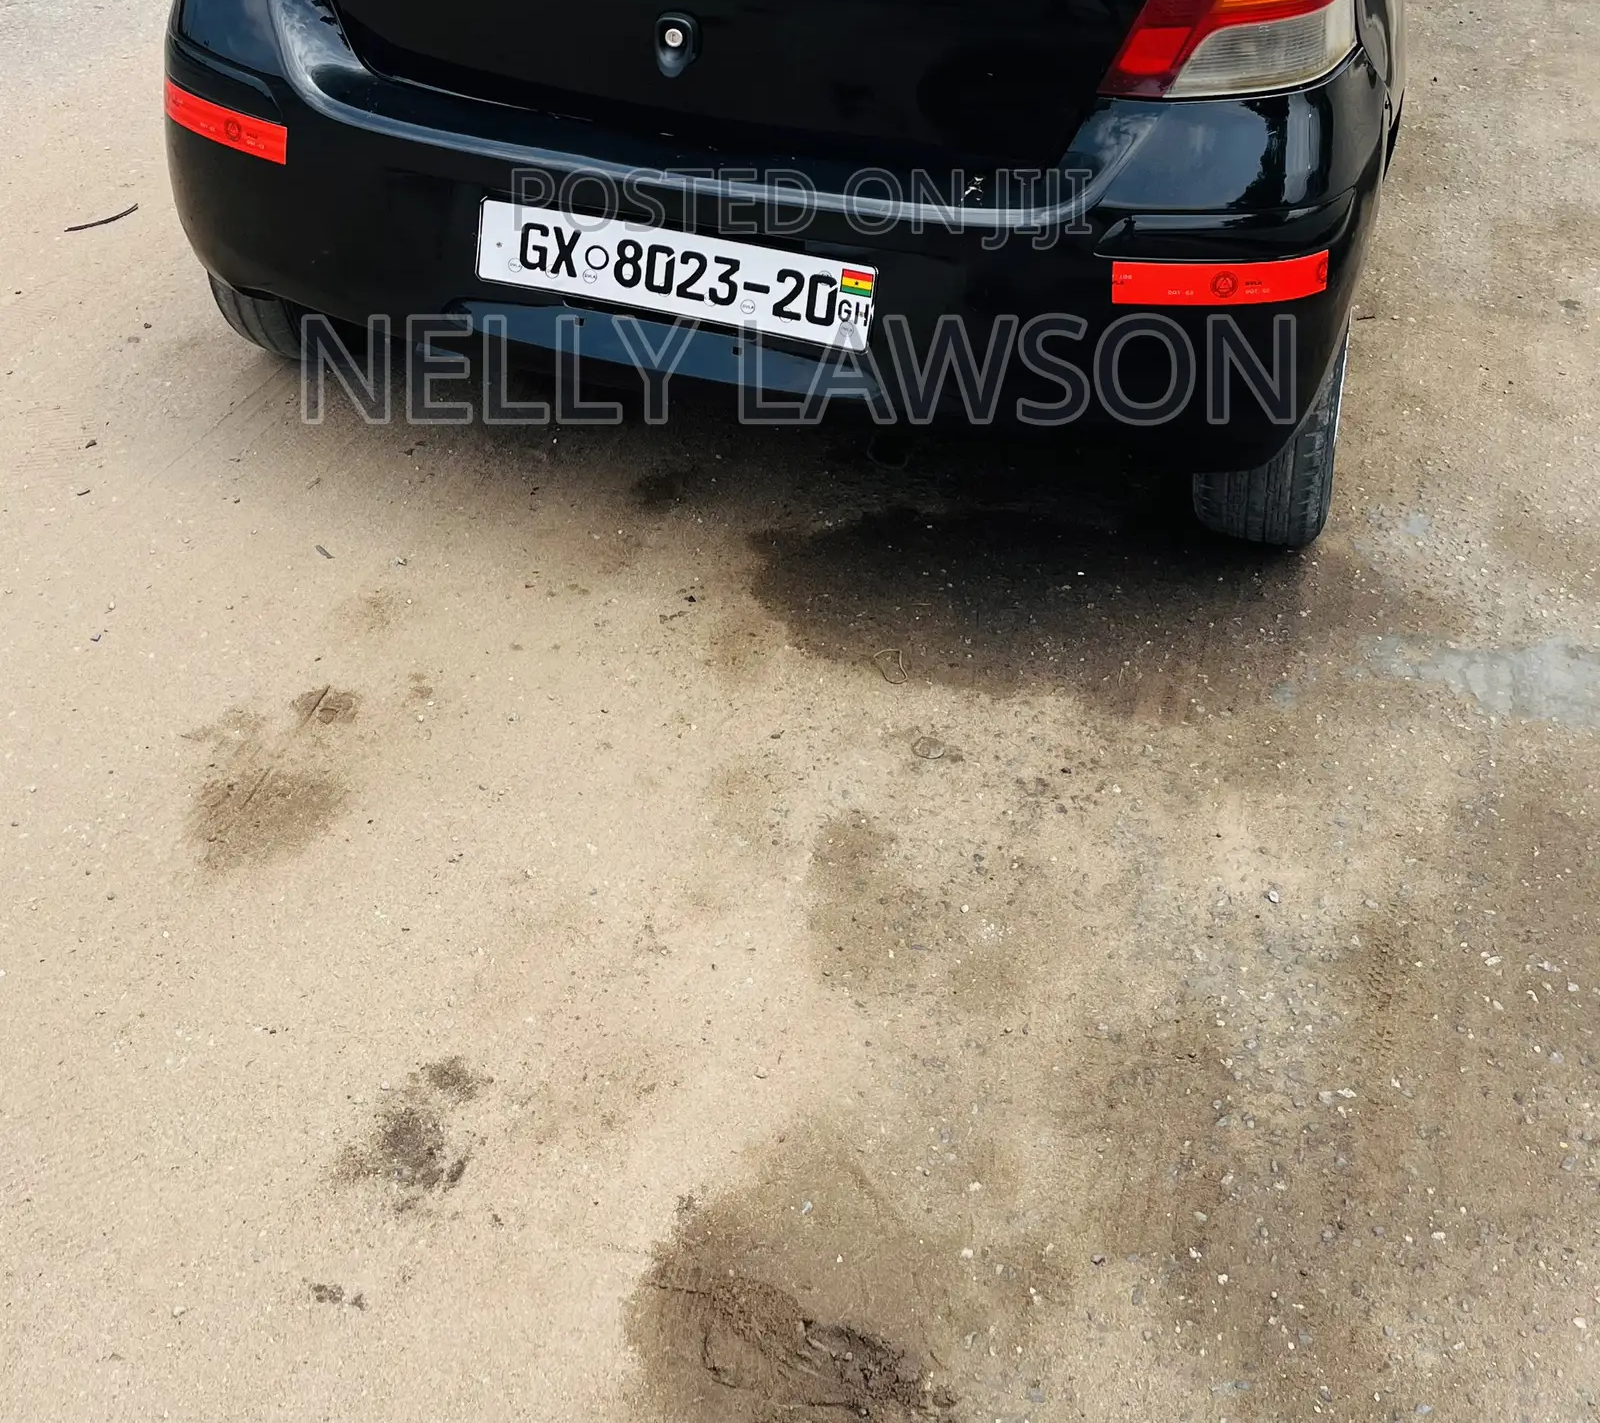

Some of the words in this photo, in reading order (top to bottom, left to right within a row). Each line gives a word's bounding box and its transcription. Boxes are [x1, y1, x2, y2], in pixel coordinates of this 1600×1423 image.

[519, 222, 581, 278] GX
[613, 239, 838, 327] 8023-20
[838, 299, 869, 327] GH
